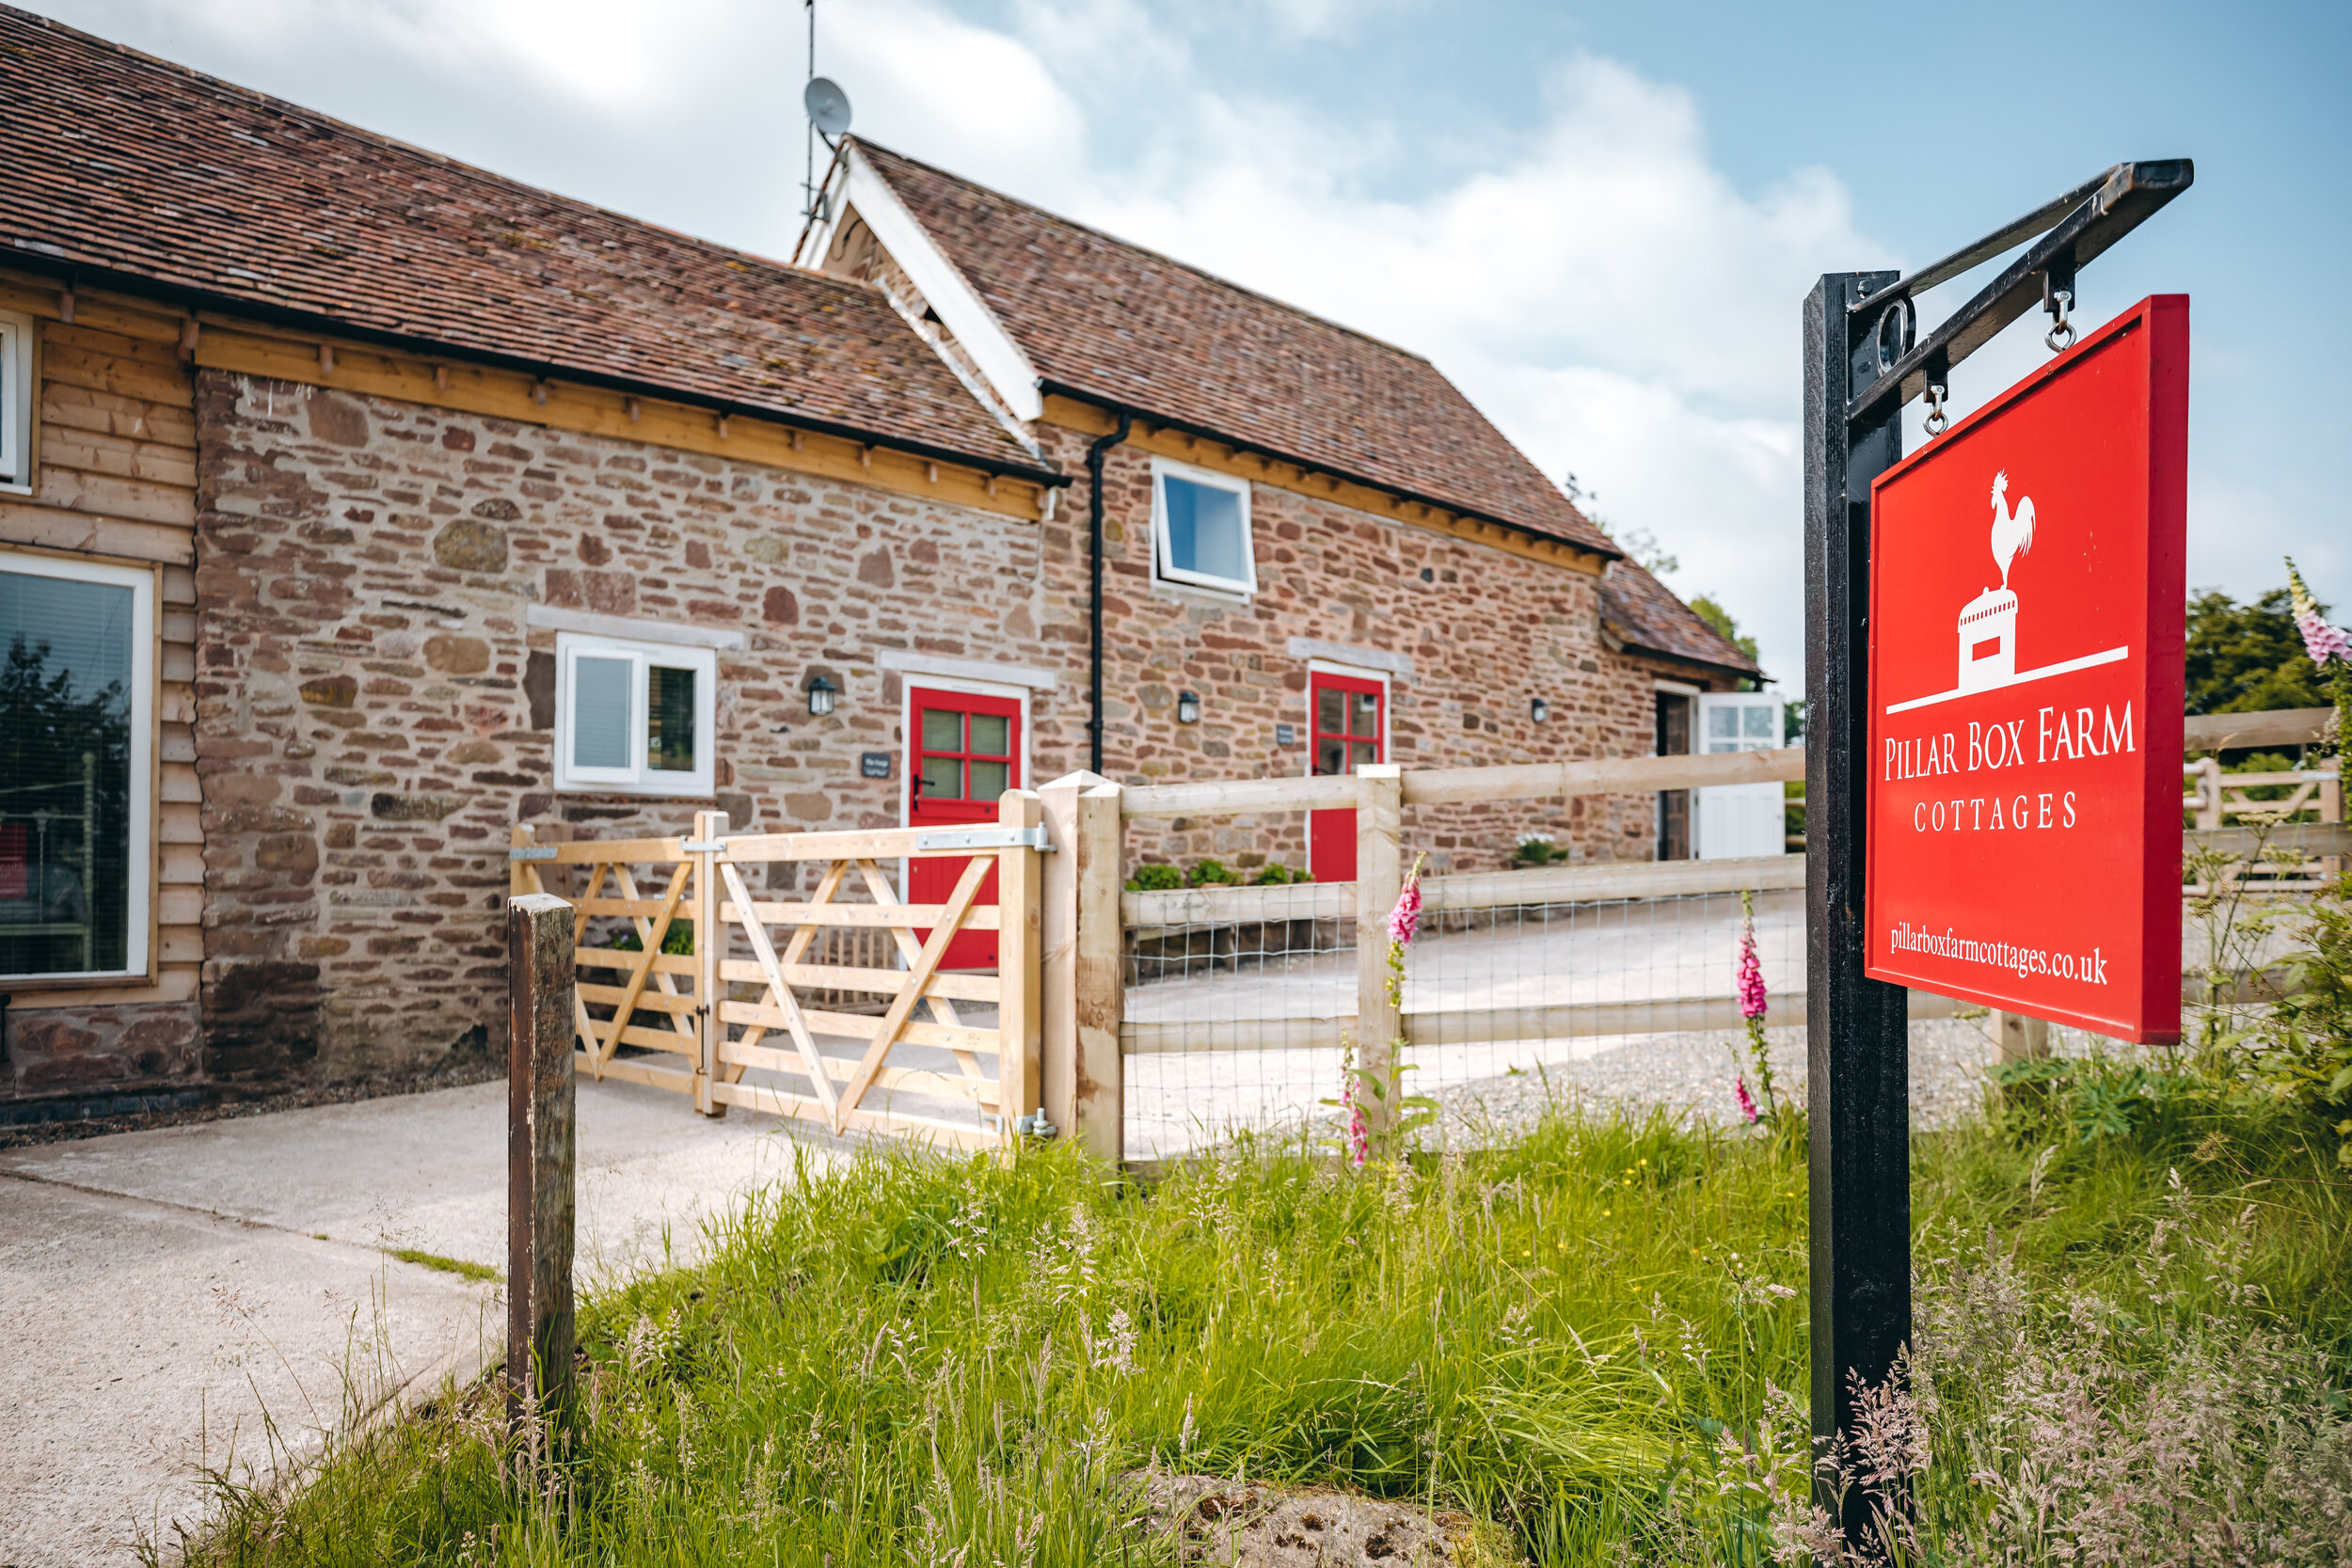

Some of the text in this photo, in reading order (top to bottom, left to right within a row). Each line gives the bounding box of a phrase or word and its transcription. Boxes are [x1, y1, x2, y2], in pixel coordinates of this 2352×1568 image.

[1884, 699, 2137, 782] PILLAR BOX FARM
[1914, 790, 2076, 832] COTTAGES
[1890, 921, 2108, 986] pillarboxfarmcottages.co.uk
